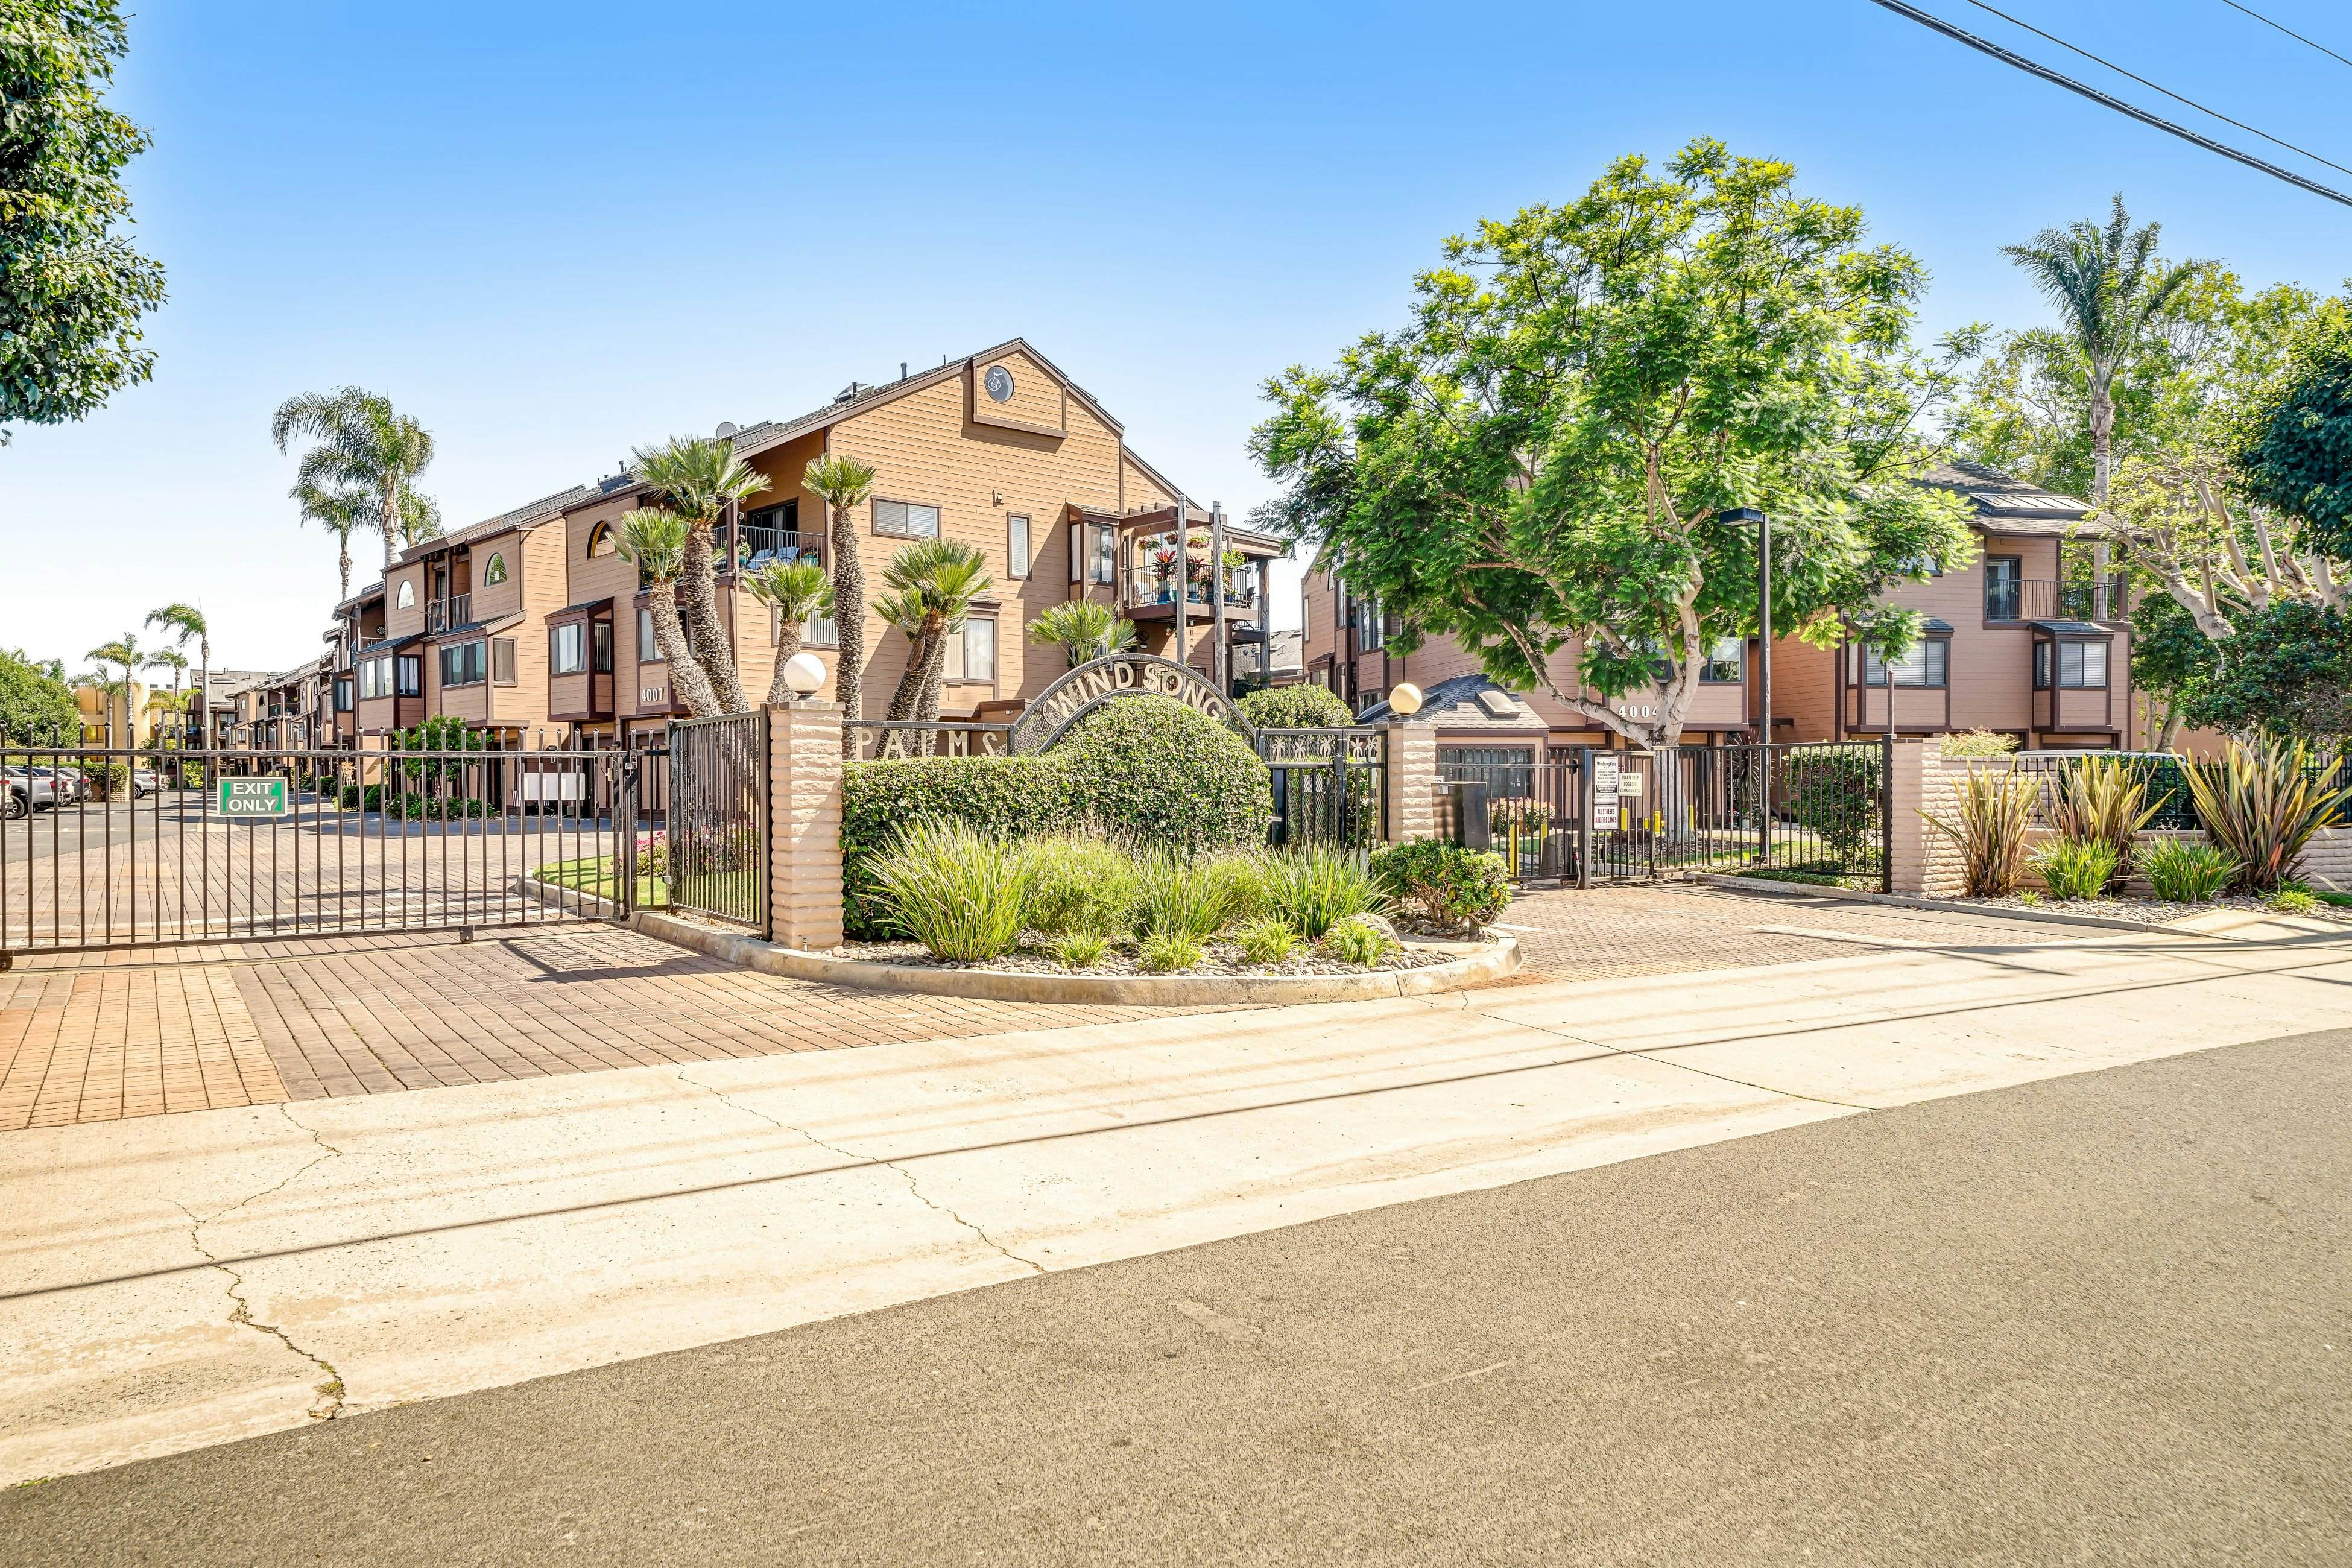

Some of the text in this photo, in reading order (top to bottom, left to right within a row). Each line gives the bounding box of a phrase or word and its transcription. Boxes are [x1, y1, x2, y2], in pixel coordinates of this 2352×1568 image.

[642, 688, 663, 702] 4007
[233, 783, 272, 794] EXIT
[229, 799, 276, 811] ONLY
